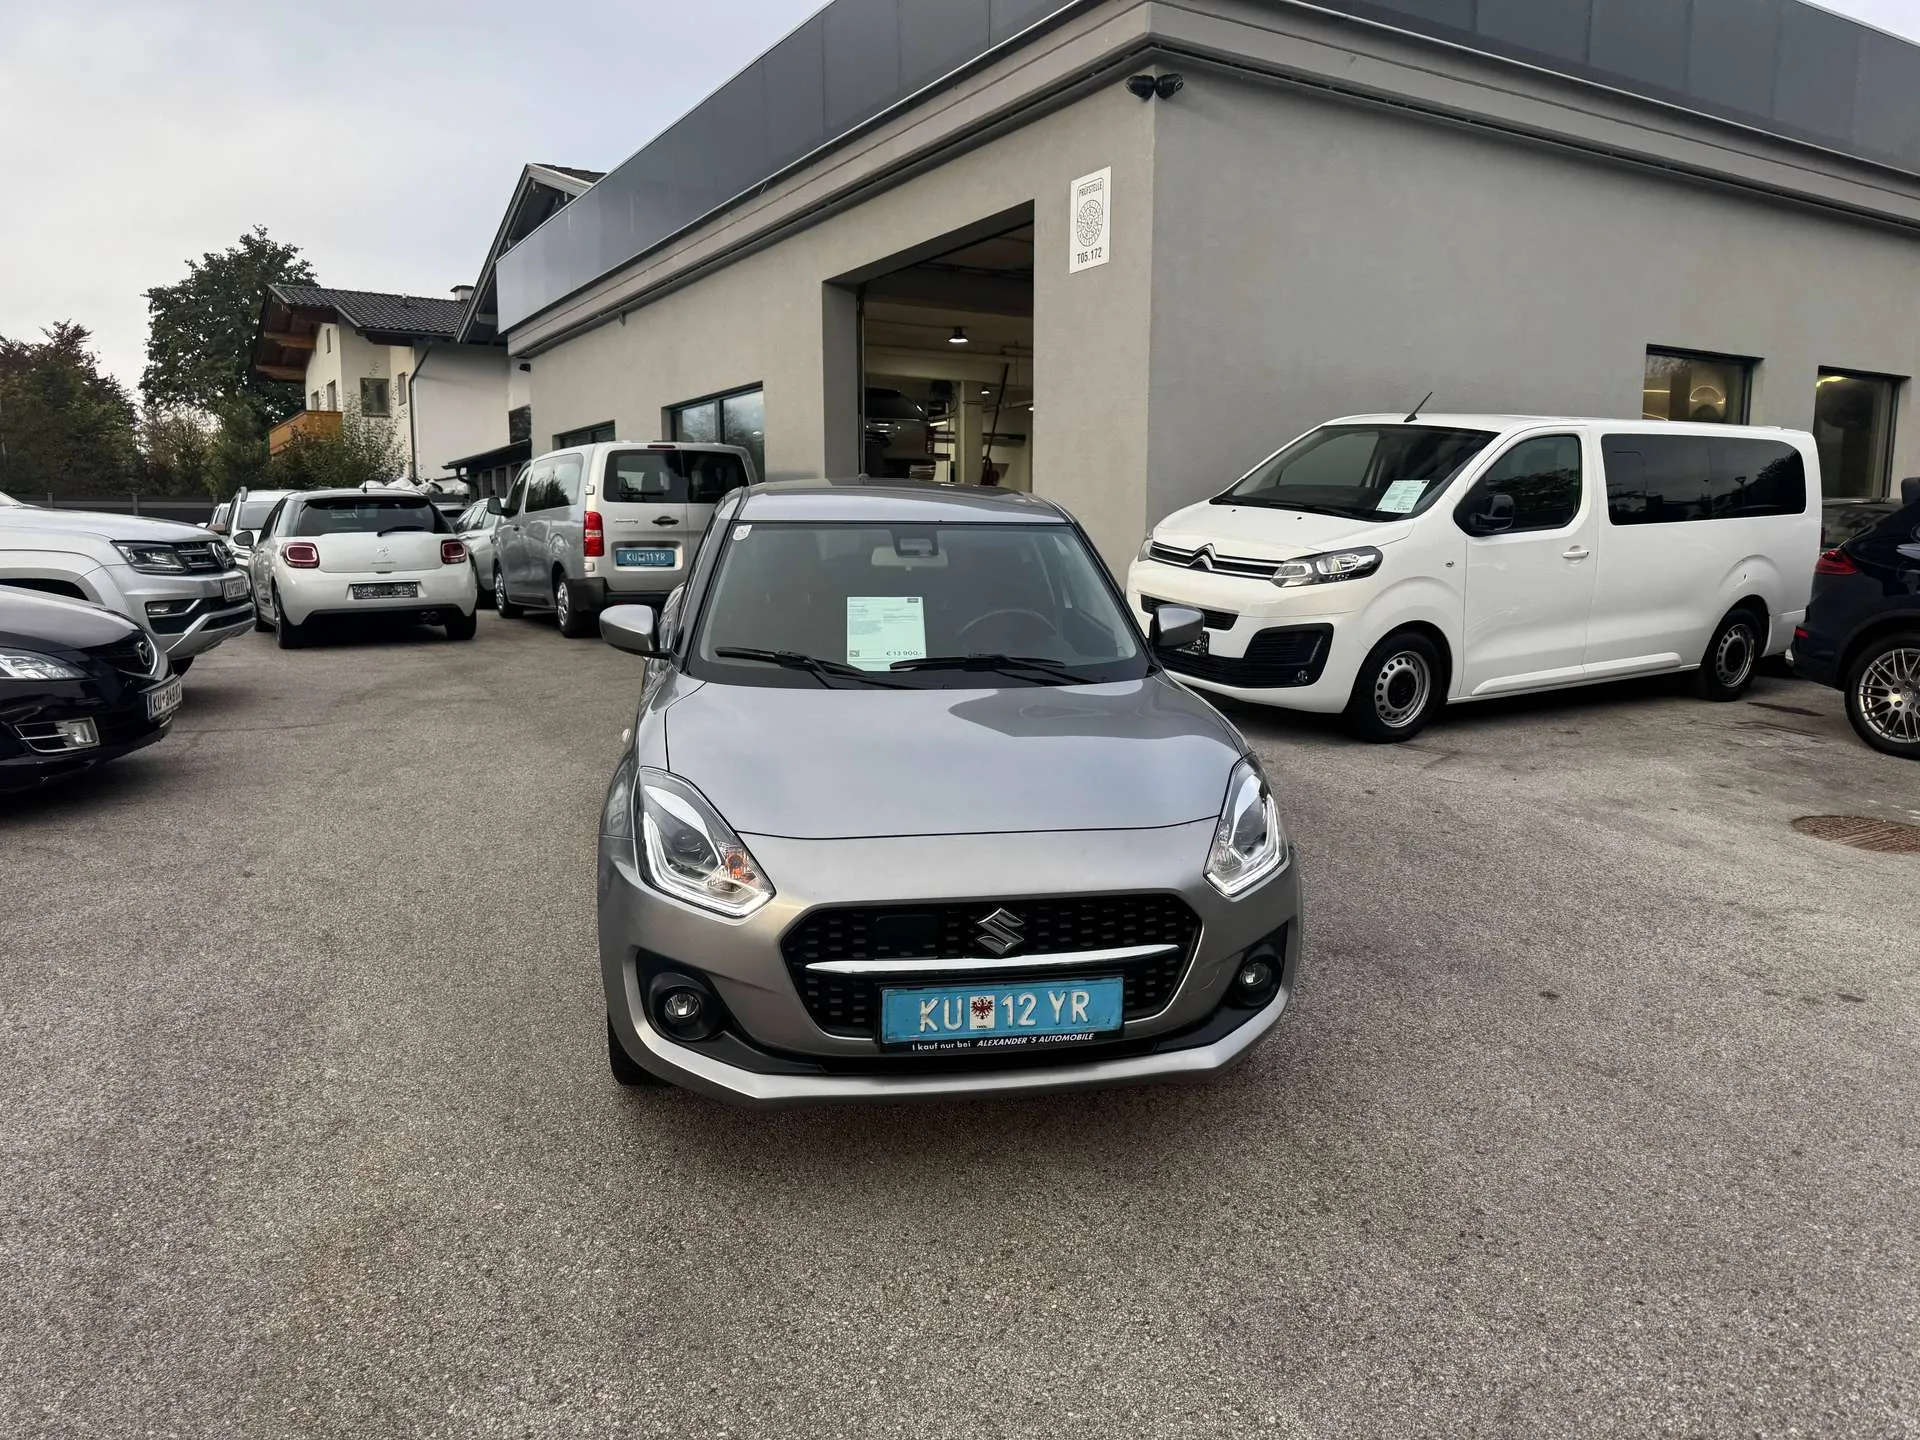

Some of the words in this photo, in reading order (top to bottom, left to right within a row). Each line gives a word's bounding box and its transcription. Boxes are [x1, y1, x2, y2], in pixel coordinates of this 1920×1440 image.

[1077, 247, 1102, 264] T05.172
[626, 553, 637, 561] KU
[919, 995, 963, 1034] KU
[1001, 993, 1038, 1027] 12
[1048, 990, 1091, 1025] YR
[918, 1042, 938, 1050] kauf
[977, 1036, 1028, 1047] ALEXANDER
[1038, 1033, 1095, 1043] AUTOMOBILE
